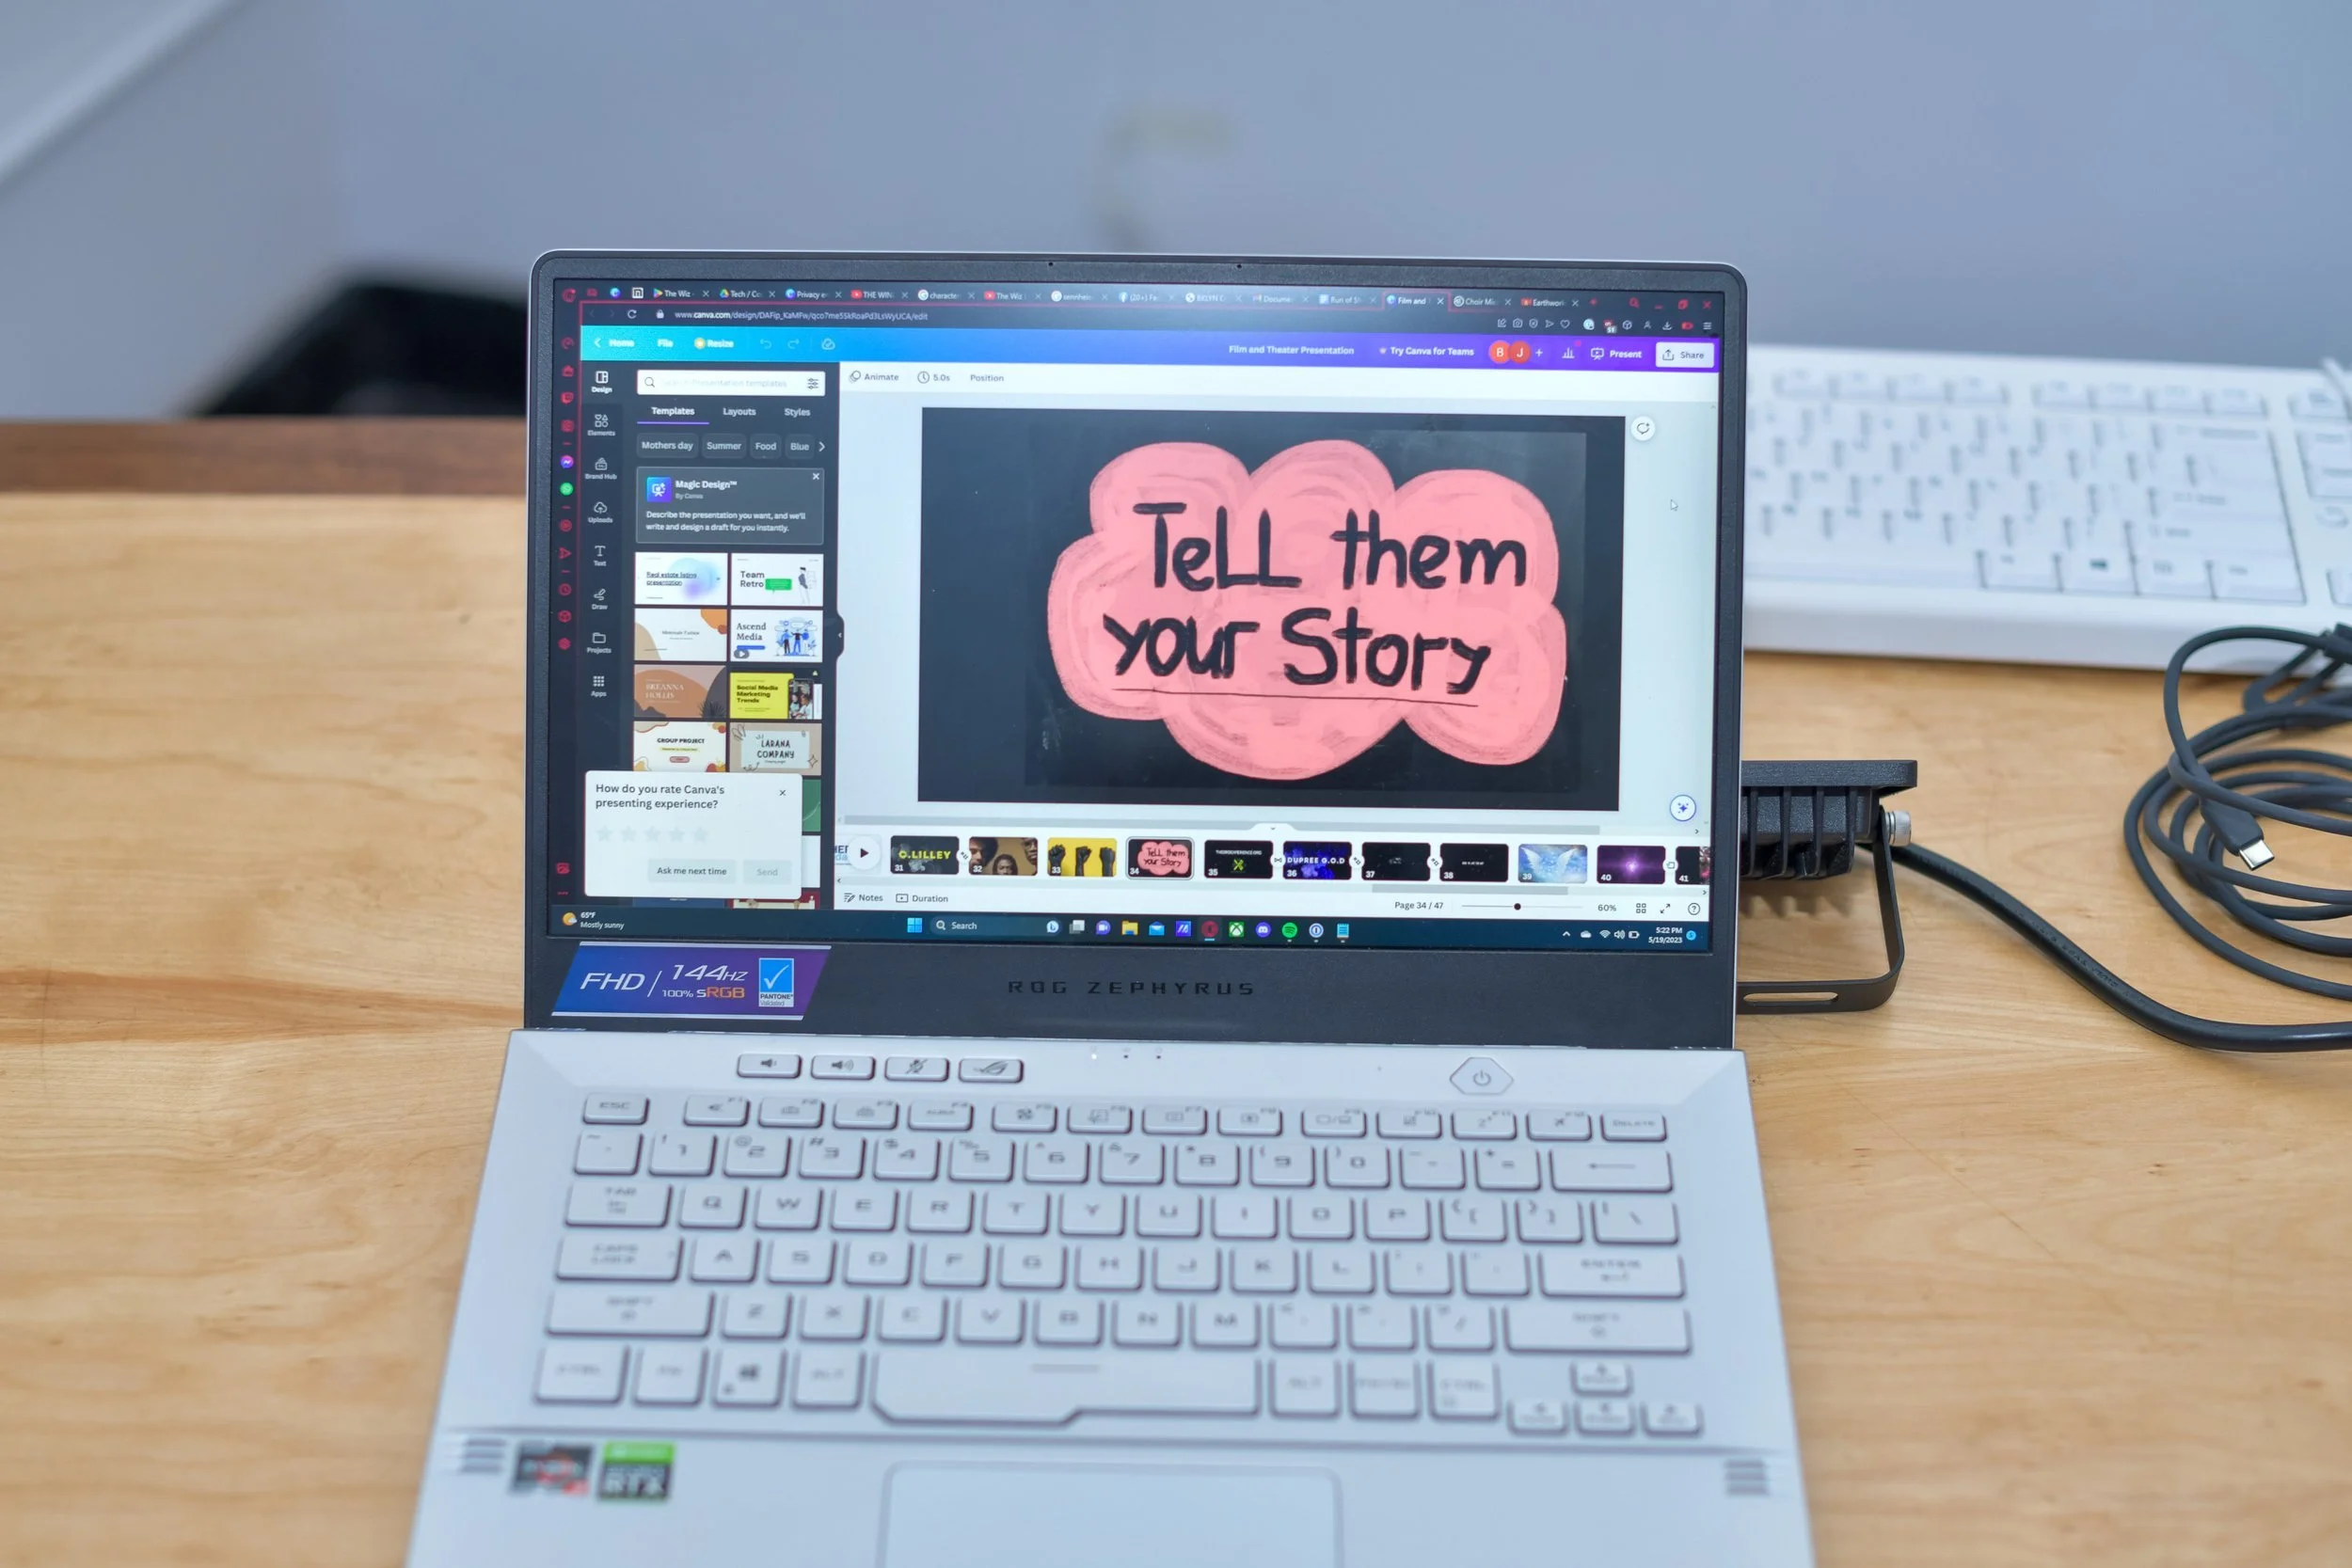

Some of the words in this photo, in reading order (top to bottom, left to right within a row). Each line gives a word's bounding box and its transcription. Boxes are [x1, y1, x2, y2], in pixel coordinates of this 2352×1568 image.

[664, 290, 677, 298] The
[678, 290, 691, 298] Wiz
[730, 290, 746, 298] Tech
[797, 291, 820, 300] Privacy
[1398, 295, 1411, 305] Film
[1412, 296, 1426, 305] and
[1465, 297, 1484, 306] Choir
[657, 339, 675, 349] File
[707, 339, 735, 349] Resize
[1229, 345, 1248, 355] Film
[1248, 345, 1265, 355] and
[1266, 346, 1298, 355] Theater
[1300, 346, 1355, 356] Presentation
[1390, 347, 1404, 357] Try
[1406, 347, 1432, 356] Canva
[1433, 347, 1446, 356] for
[1447, 347, 1474, 356] Teams
[1496, 346, 1504, 357] B
[1516, 347, 1524, 358] J
[1609, 349, 1643, 358] Present
[1680, 351, 1705, 359] Share
[864, 372, 899, 381] Animate
[932, 373, 950, 382] 5.0s
[970, 374, 1005, 383] Position
[746, 380, 787, 389] templates
[592, 386, 612, 396] Design
[651, 406, 695, 417] Templates
[723, 407, 756, 418] Layouts
[785, 408, 811, 419] Styles
[642, 441, 676, 450] Mothers
[677, 442, 694, 451] day
[707, 442, 742, 451] Summer
[755, 442, 777, 451] Food
[675, 480, 701, 490] Magic
[645, 510, 678, 518] Describe
[691, 511, 738, 520] presentation
[739, 512, 753, 521] you
[753, 512, 773, 520] want,
[788, 512, 806, 520] we'll
[588, 516, 614, 526] Uploads
[645, 522, 664, 531] write
[680, 523, 705, 533] design
[710, 523, 729, 531] draft
[729, 523, 741, 531] for
[741, 525, 755, 533] you
[755, 524, 789, 533] instantly.
[1328, 508, 1527, 590] them
[740, 570, 765, 578] Team
[740, 579, 764, 588] Retro
[737, 622, 767, 631] Ascend
[737, 633, 763, 641] Media
[587, 646, 612, 656] Projects
[1103, 612, 1261, 680] your
[1281, 606, 1492, 694] Story
[591, 690, 608, 699] Apps
[737, 690, 771, 699] Marketing
[756, 750, 795, 760] COMPANY
[596, 784, 620, 794] How
[622, 785, 636, 794] do
[637, 787, 659, 797] you
[660, 785, 682, 795] rate
[684, 785, 725, 795] Canva's
[595, 800, 653, 810] presenting
[655, 800, 719, 811] experience?
[1167, 847, 1185, 857] them
[1143, 858, 1160, 866] your
[1160, 858, 1182, 867] Story
[1286, 856, 1319, 864] DUPREE
[657, 867, 673, 876] Ask
[756, 868, 779, 877] Send
[894, 864, 904, 873] 31
[1521, 872, 1533, 880] 39
[858, 895, 883, 903] Notes
[912, 895, 949, 903] Duration
[1394, 901, 1414, 911] Page
[1597, 904, 1617, 912] 60%
[580, 922, 604, 930] Mostly
[604, 923, 625, 931] sunny
[951, 921, 977, 930] Search
[1648, 936, 1683, 944] 5/19/2023
[580, 973, 646, 990] FHD
[661, 990, 694, 998] 100%
[695, 987, 745, 998] sRGB
[1008, 981, 1068, 995] ROG
[1088, 981, 1255, 995] ZEPHYRUS
